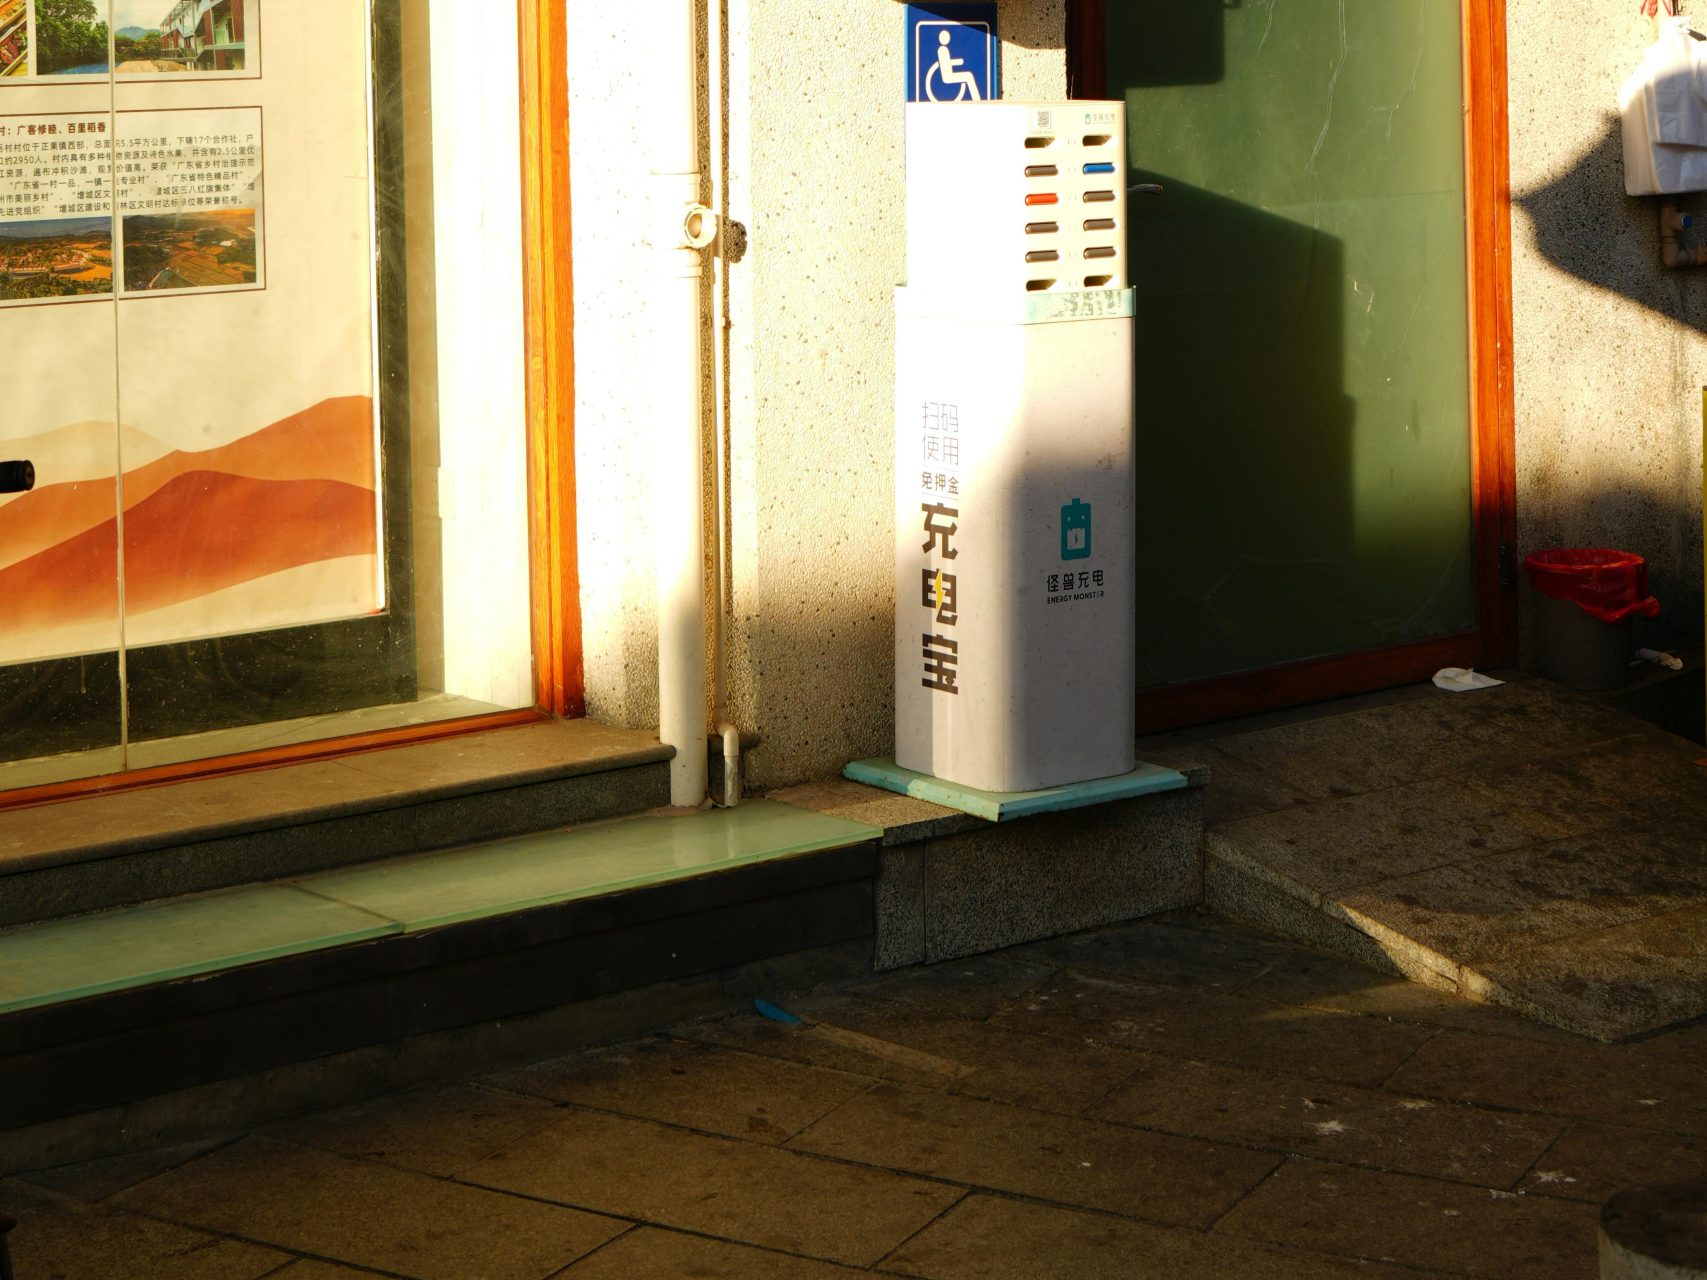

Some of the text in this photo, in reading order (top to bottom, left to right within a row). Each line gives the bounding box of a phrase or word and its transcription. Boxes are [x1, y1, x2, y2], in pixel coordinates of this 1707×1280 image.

[922, 401, 958, 433] 扫码
[922, 433, 959, 466] 使用
[921, 471, 959, 495] 免押金
[1047, 569, 1104, 592] 怪兽充电
[921, 502, 959, 695] 充电宝
[1047, 590, 1104, 605] ENERGY MONSTER
